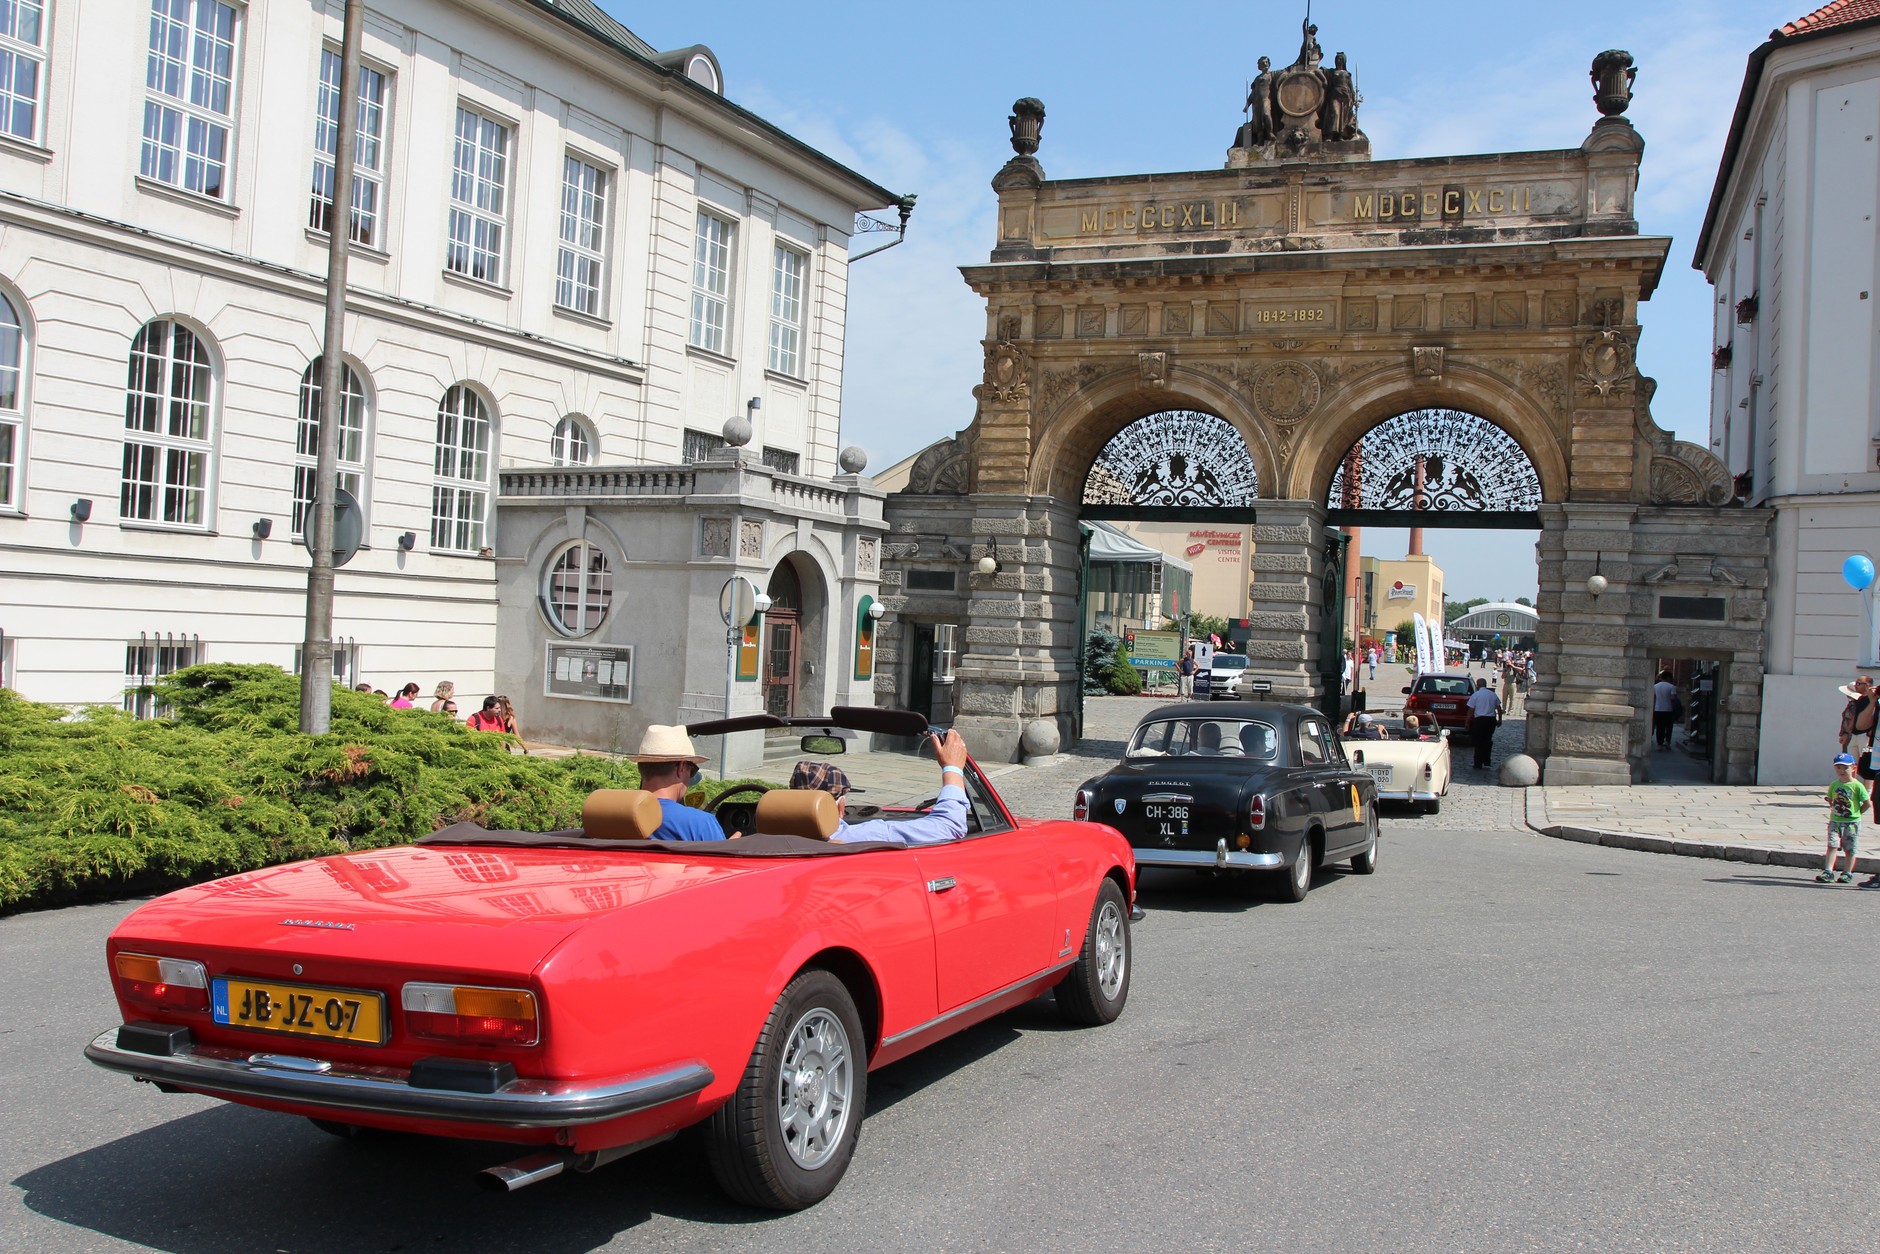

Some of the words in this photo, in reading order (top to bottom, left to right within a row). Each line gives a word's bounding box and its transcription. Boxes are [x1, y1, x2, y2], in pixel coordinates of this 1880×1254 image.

[1353, 187, 1530, 218] MDCCCXCII
[1081, 202, 1237, 232] MDCCCXLII
[1257, 309, 1323, 322] 1842-1892
[1135, 658, 1168, 667] PARKING
[1146, 805, 1189, 819] CH-386
[1160, 822, 1175, 835] XL
[282, 918, 356, 931] PEUGEOT
[216, 1005, 228, 1016] NL
[238, 988, 362, 1033] JB-JZ-07
